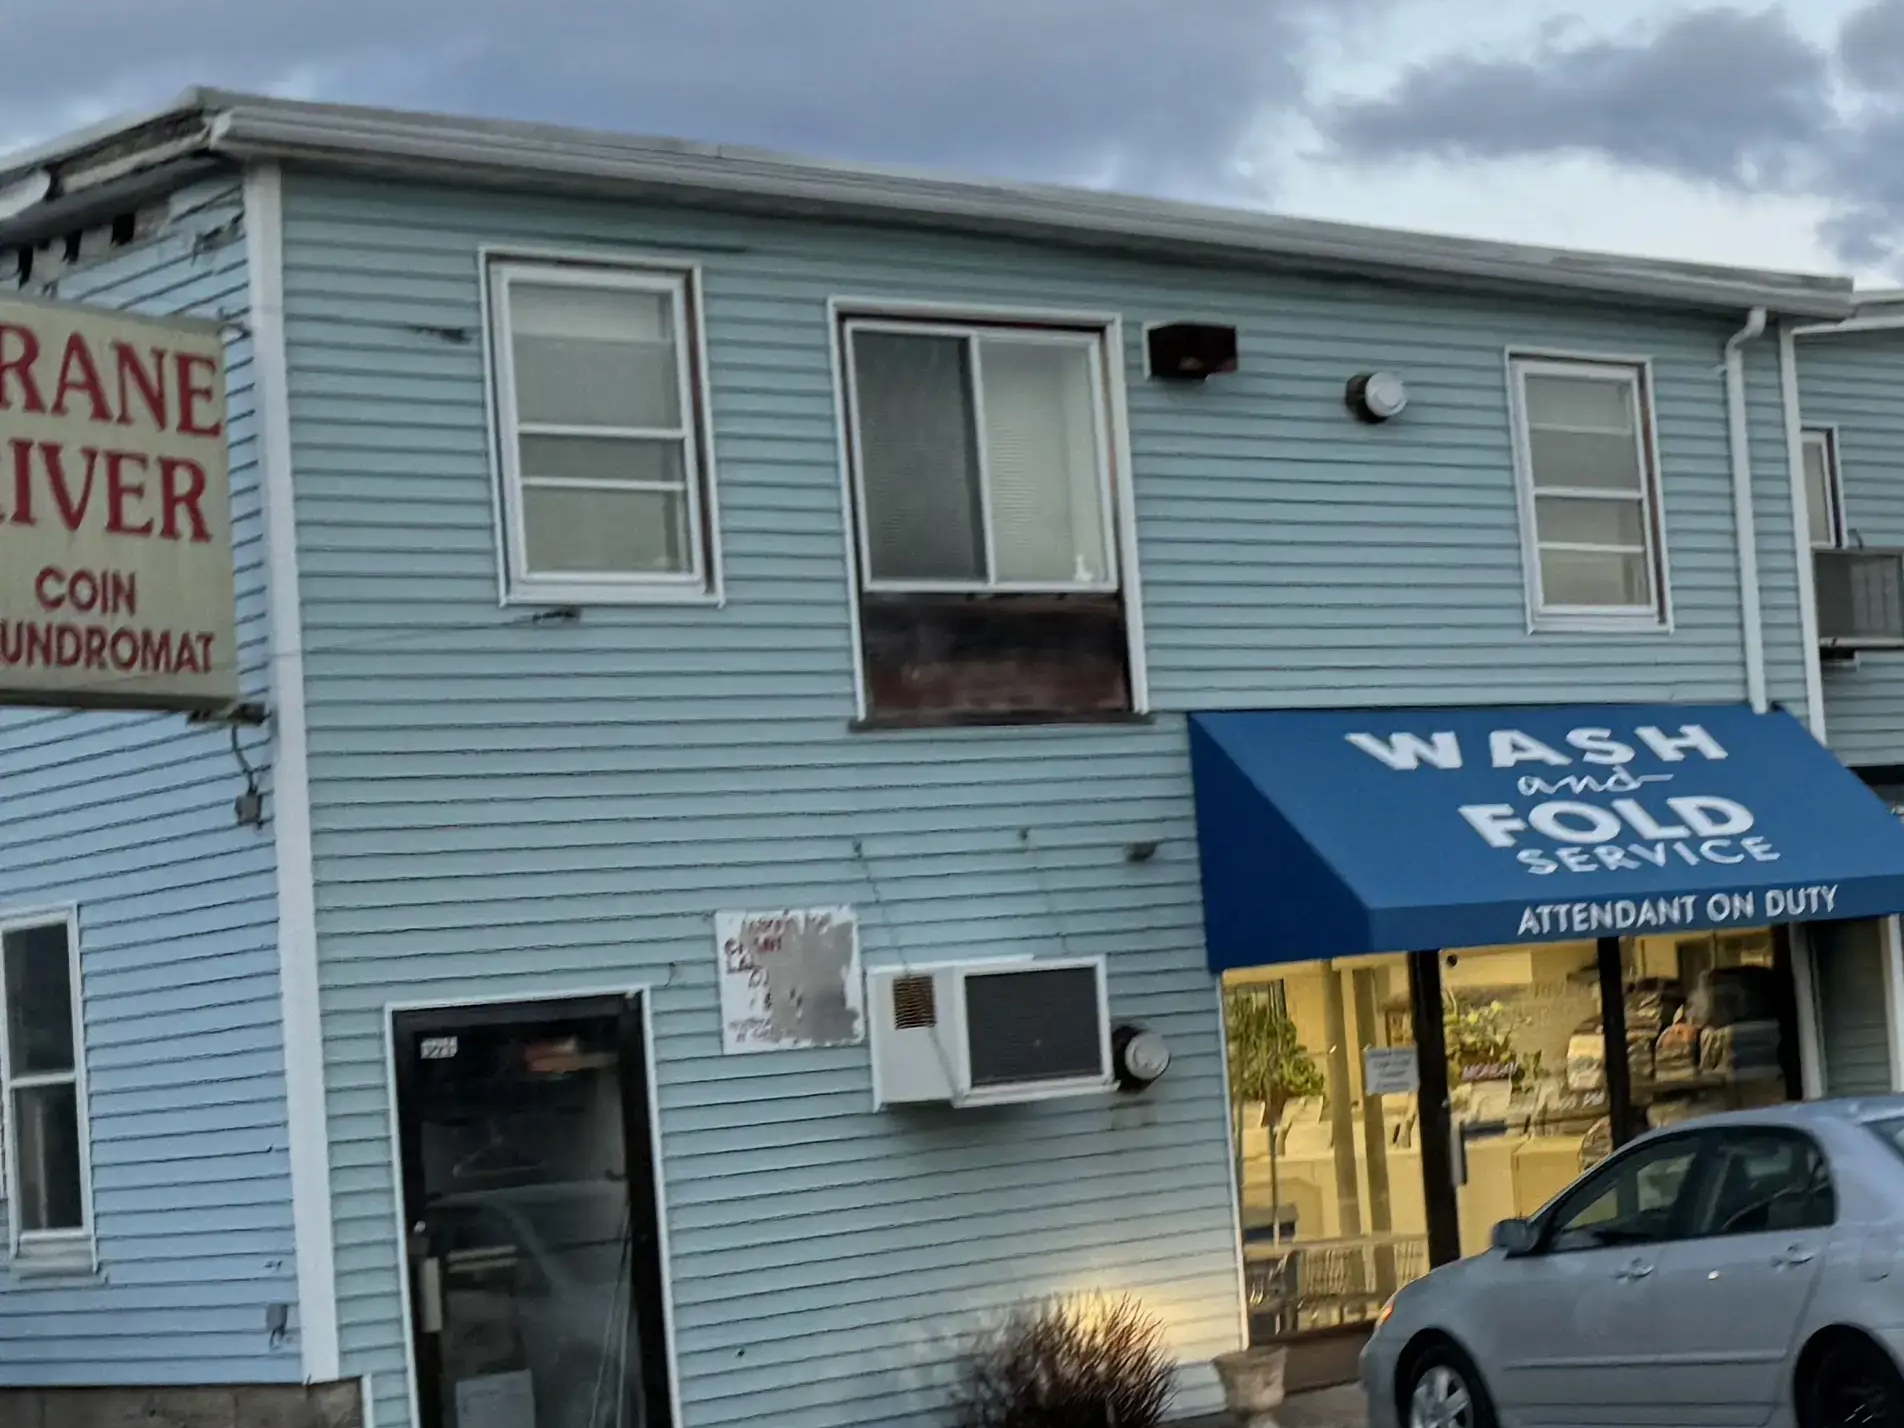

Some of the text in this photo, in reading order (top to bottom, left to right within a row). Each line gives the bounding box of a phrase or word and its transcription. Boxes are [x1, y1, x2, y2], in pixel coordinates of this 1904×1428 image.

[0, 436, 213, 543] IVER
[34, 565, 137, 616] COIN
[1344, 723, 1729, 770] WASH
[1516, 765, 1675, 796] and
[1457, 795, 1756, 848] FOLD
[1516, 836, 1781, 875] SERVICE
[1517, 884, 1838, 937] ATTENDANT ON DUTY
